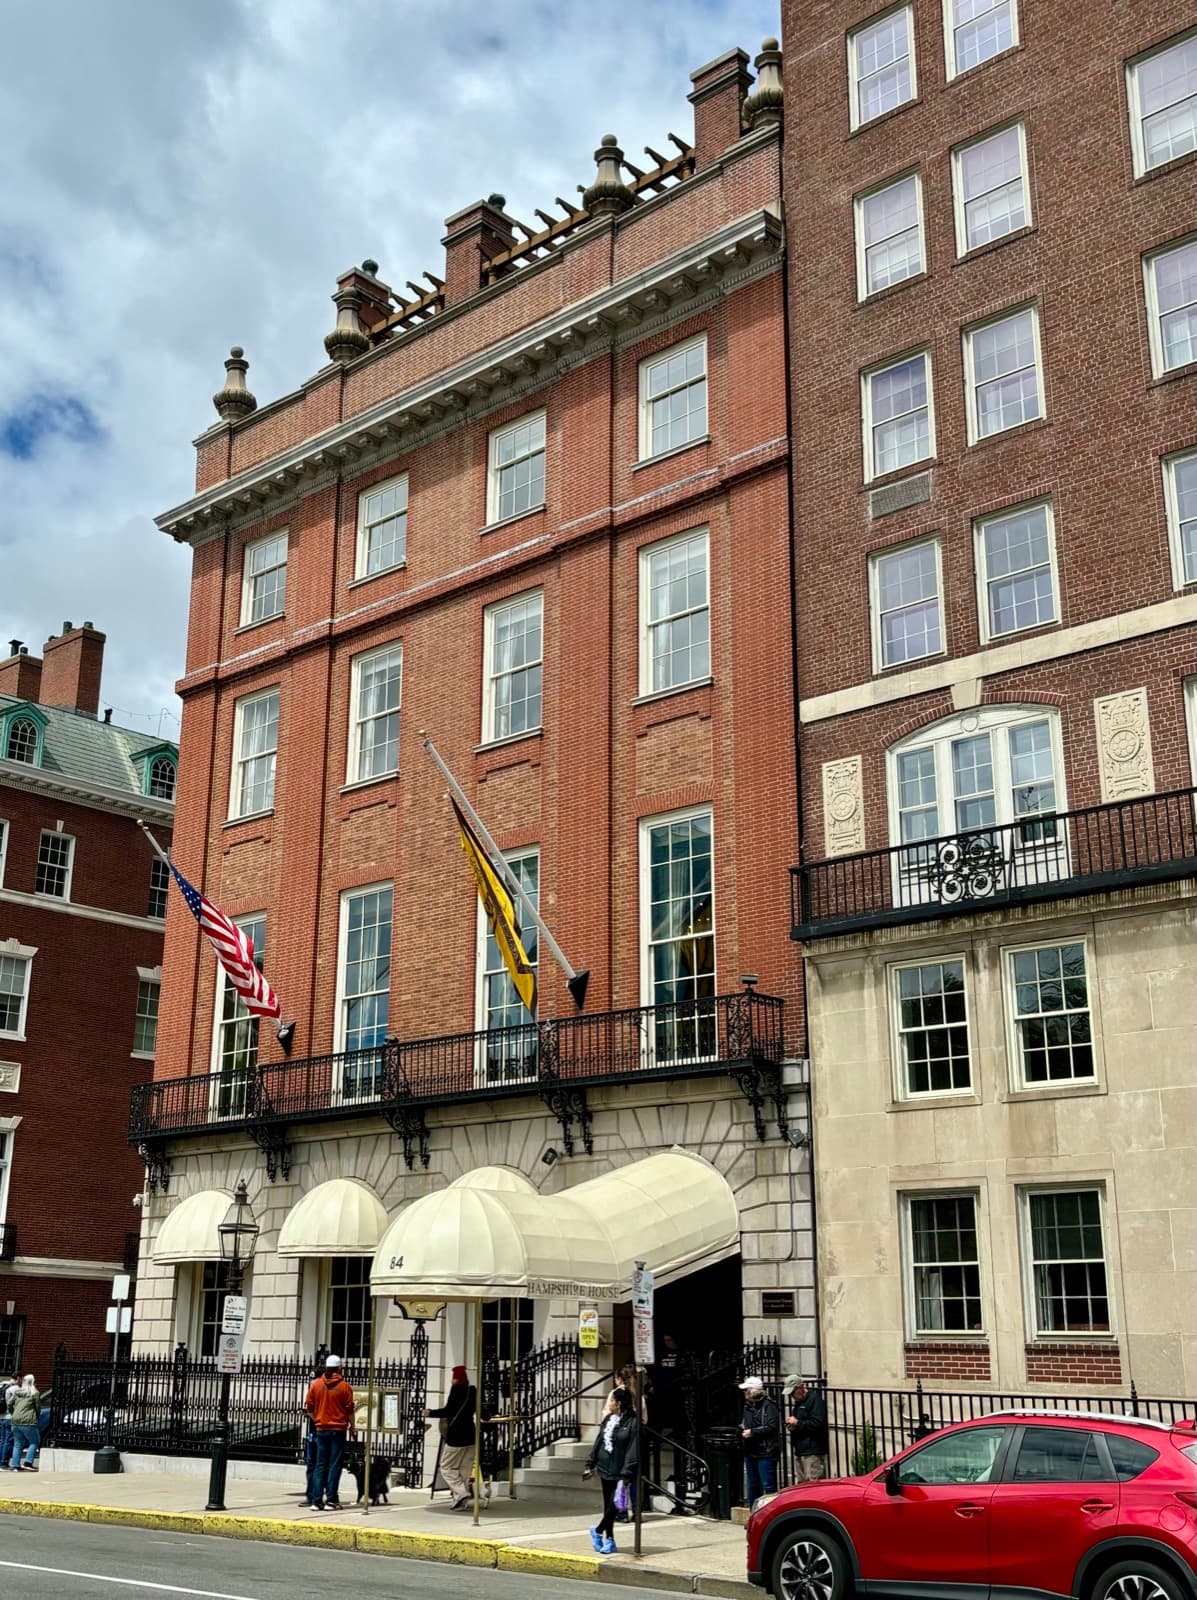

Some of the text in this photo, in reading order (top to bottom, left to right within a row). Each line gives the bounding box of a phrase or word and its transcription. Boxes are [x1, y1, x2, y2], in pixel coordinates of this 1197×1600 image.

[390, 1255, 404, 1270] 84
[527, 1282, 586, 1297] HAMPSHIRE
[588, 1285, 620, 1298] HOUSE
